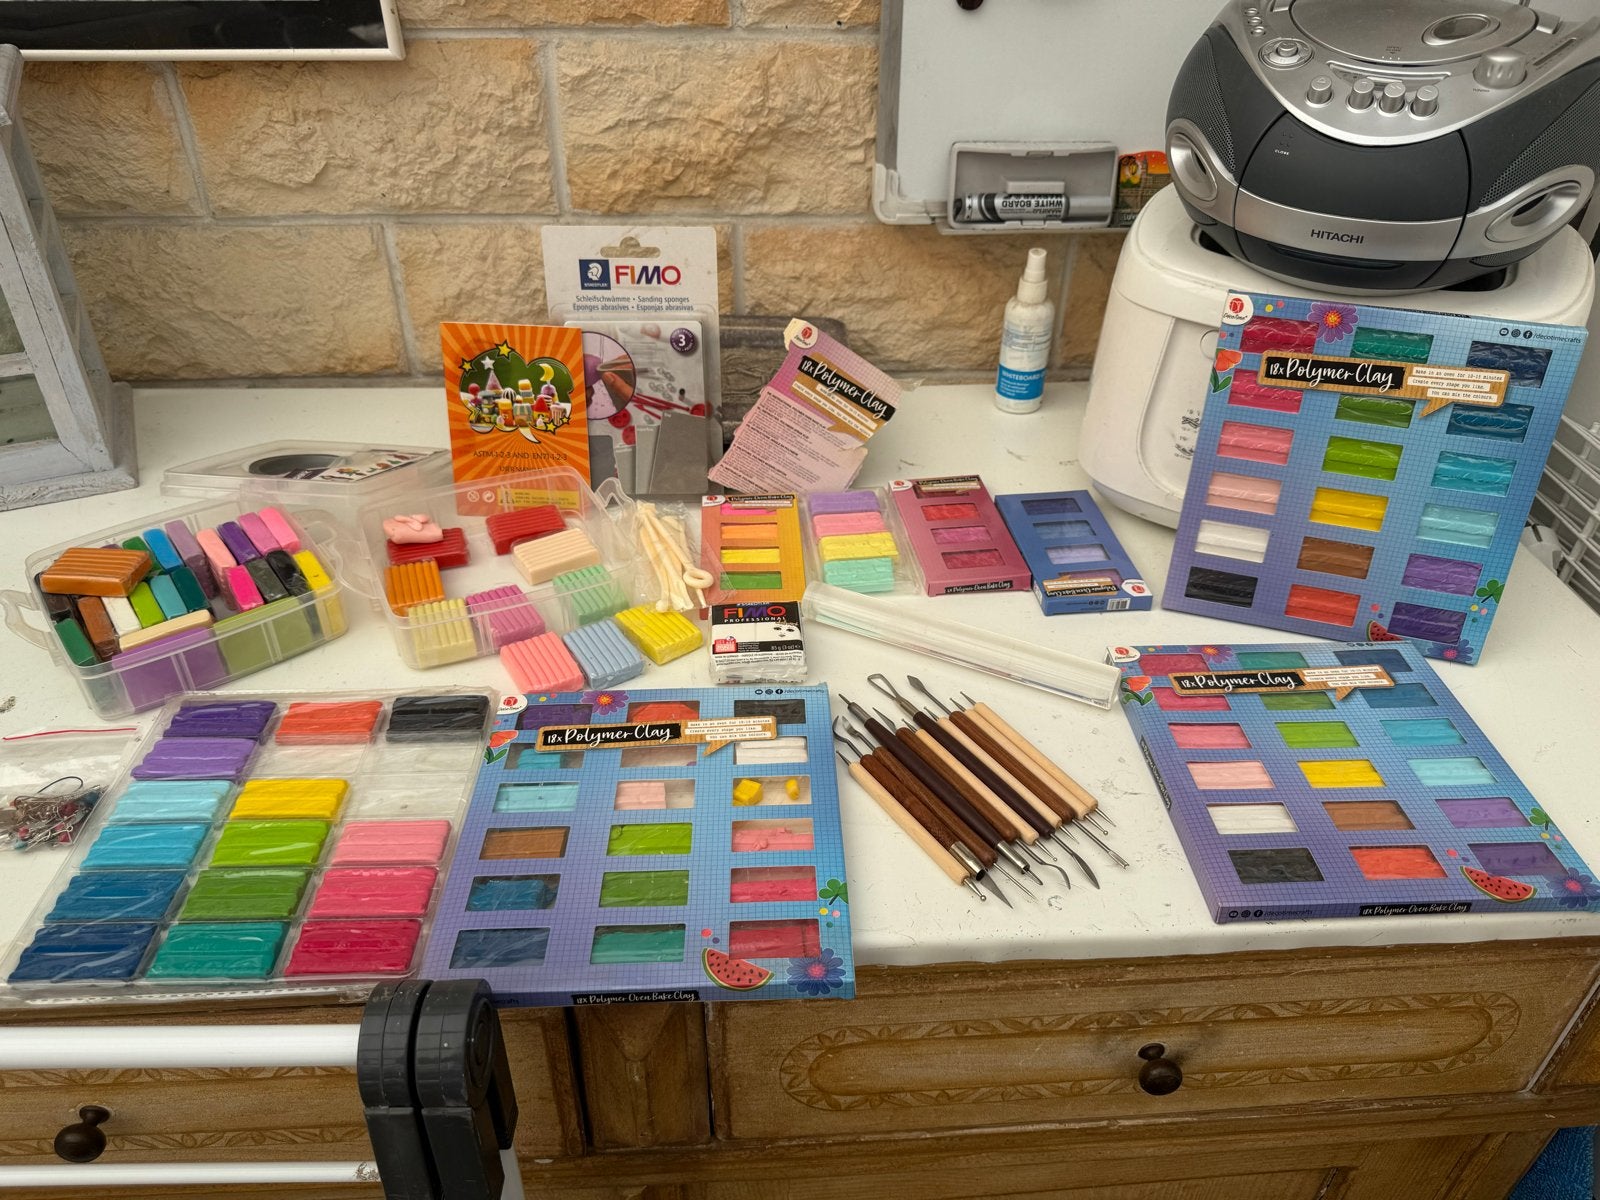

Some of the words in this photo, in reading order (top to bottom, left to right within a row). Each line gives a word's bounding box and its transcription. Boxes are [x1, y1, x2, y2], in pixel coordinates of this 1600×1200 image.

[1002, 200, 1032, 208] BOARD
[1034, 200, 1063, 208] WHITE
[1310, 229, 1364, 244] HITACHI
[614, 265, 682, 286] FIMO
[638, 296, 662, 304] Sanding
[664, 296, 690, 304] sponges
[678, 334, 686, 346] 3
[1270, 363, 1284, 376] 18x
[1286, 358, 1354, 387] Polymer
[1355, 363, 1396, 393] Clay
[800, 360, 815, 374] 18x
[812, 361, 862, 398] Polymer
[860, 390, 888, 420] Clay
[724, 606, 786, 618] FIMO
[1181, 680, 1196, 688] 18x
[1194, 675, 1258, 692] Polymer
[1258, 672, 1297, 689] Clay
[548, 734, 562, 744] 18x
[564, 728, 633, 747] Polymer
[634, 724, 674, 743] Clay
[1373, 907, 1408, 916] Polymer
[1408, 905, 1429, 914] Oven
[1429, 904, 1449, 913] Bake
[1449, 903, 1467, 913] Clay
[589, 995, 627, 1005] Polymer
[628, 993, 651, 1002] Oven
[652, 992, 672, 1001] Bake
[674, 991, 696, 1001] Clay
